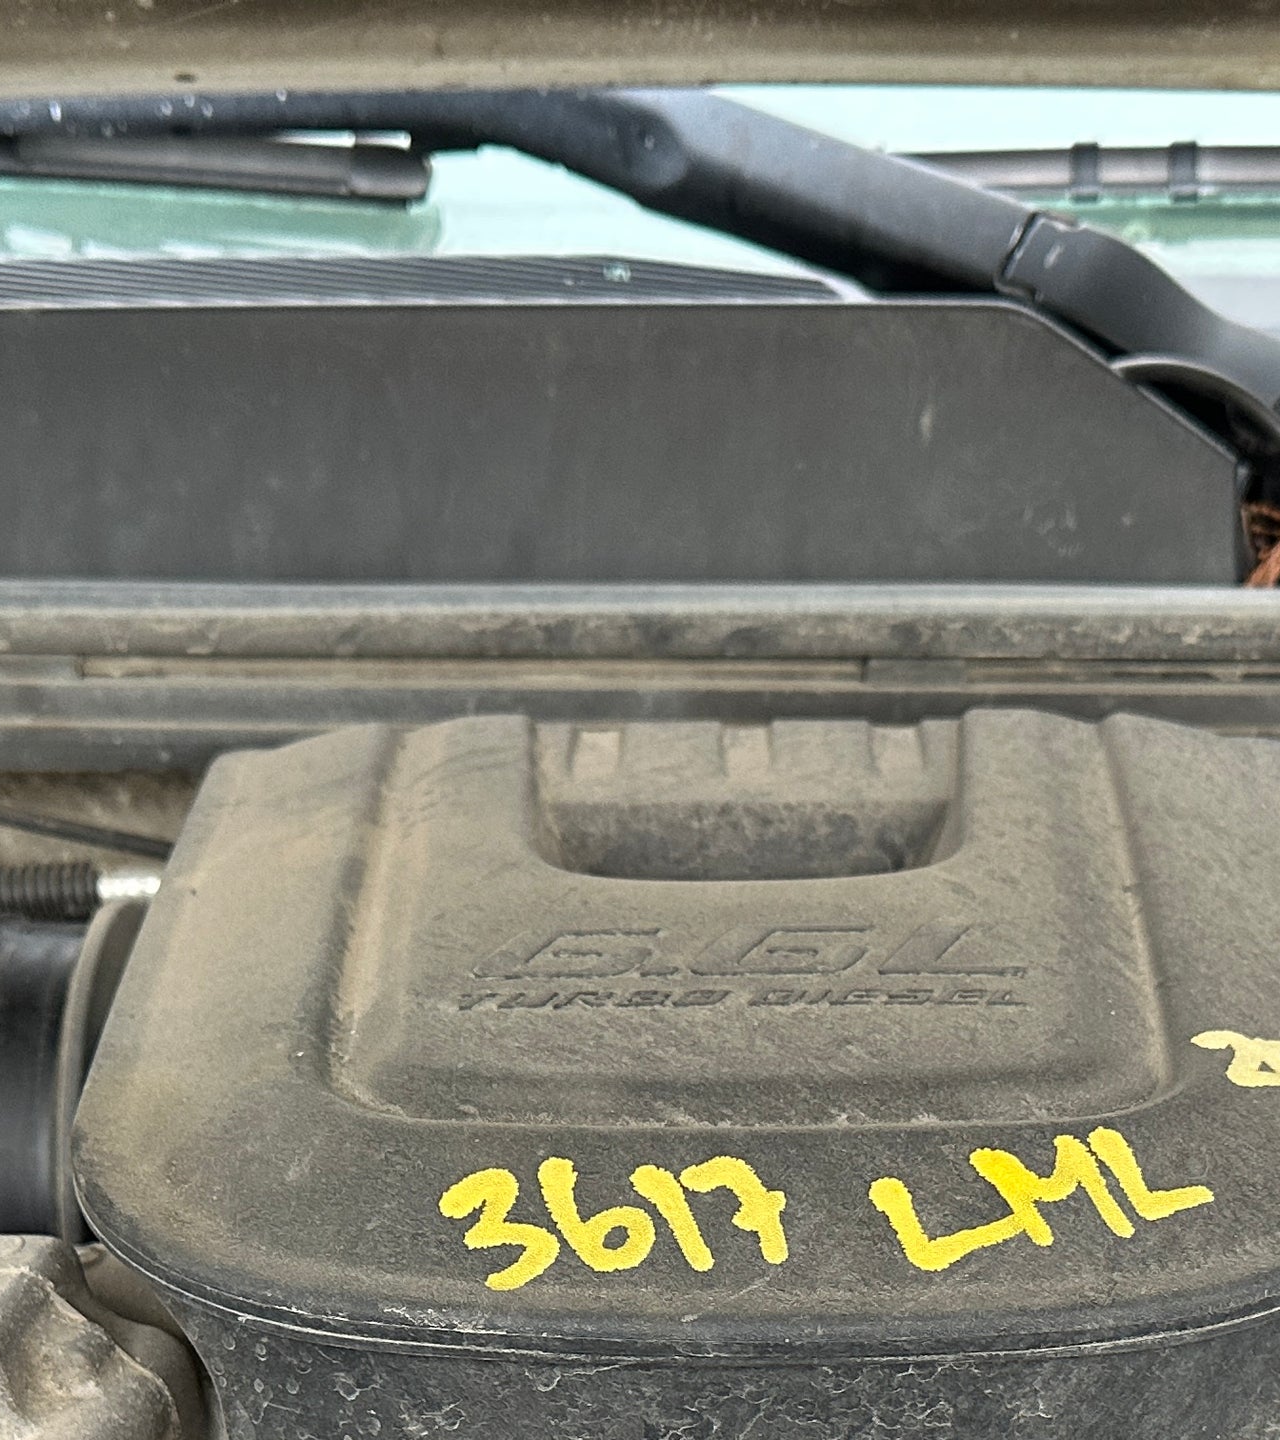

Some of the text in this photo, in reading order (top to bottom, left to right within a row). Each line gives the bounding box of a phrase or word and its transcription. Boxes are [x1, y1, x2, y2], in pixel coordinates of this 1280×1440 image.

[473, 922, 1028, 979] 6.6L
[455, 987, 1028, 1011] TURBO DIESEL
[440, 1126, 1216, 1290] 3617 LML
